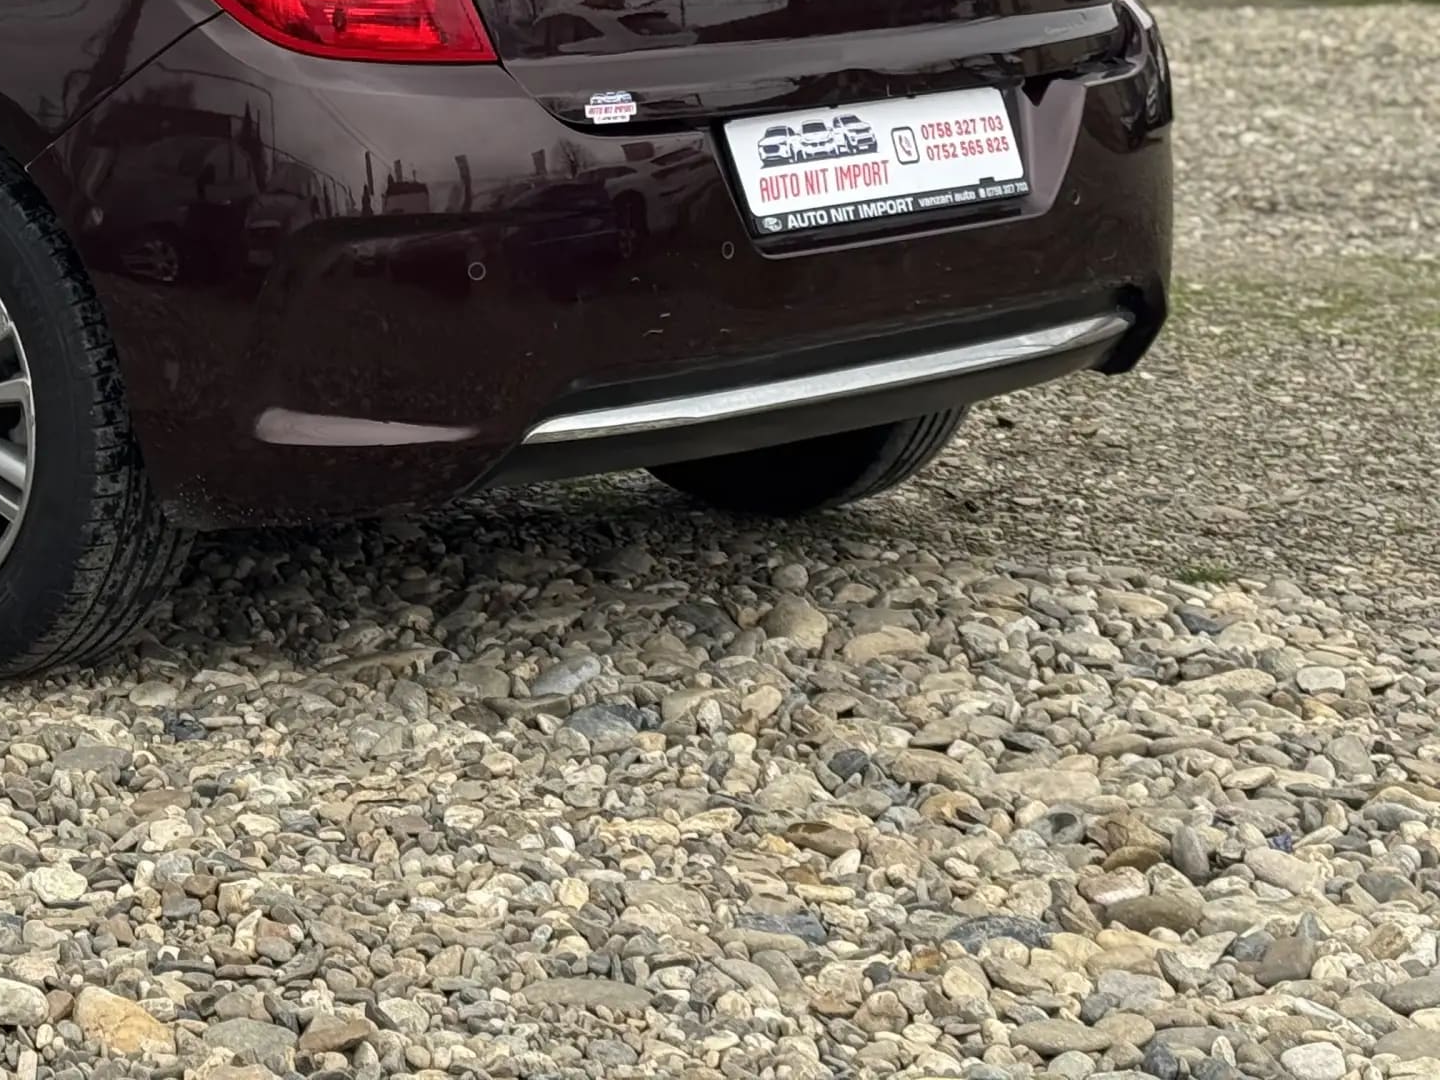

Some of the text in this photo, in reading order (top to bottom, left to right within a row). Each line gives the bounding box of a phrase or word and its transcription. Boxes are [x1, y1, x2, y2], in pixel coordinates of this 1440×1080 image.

[920, 115, 1004, 141] 0758 327 703
[926, 136, 1010, 161] 0752 565 825
[759, 160, 890, 203] AUTO NIT IMPORT
[787, 209, 828, 229] AUTO
[829, 205, 856, 224] NIT
[859, 197, 914, 219] IMPORT
[954, 188, 977, 203] auto
